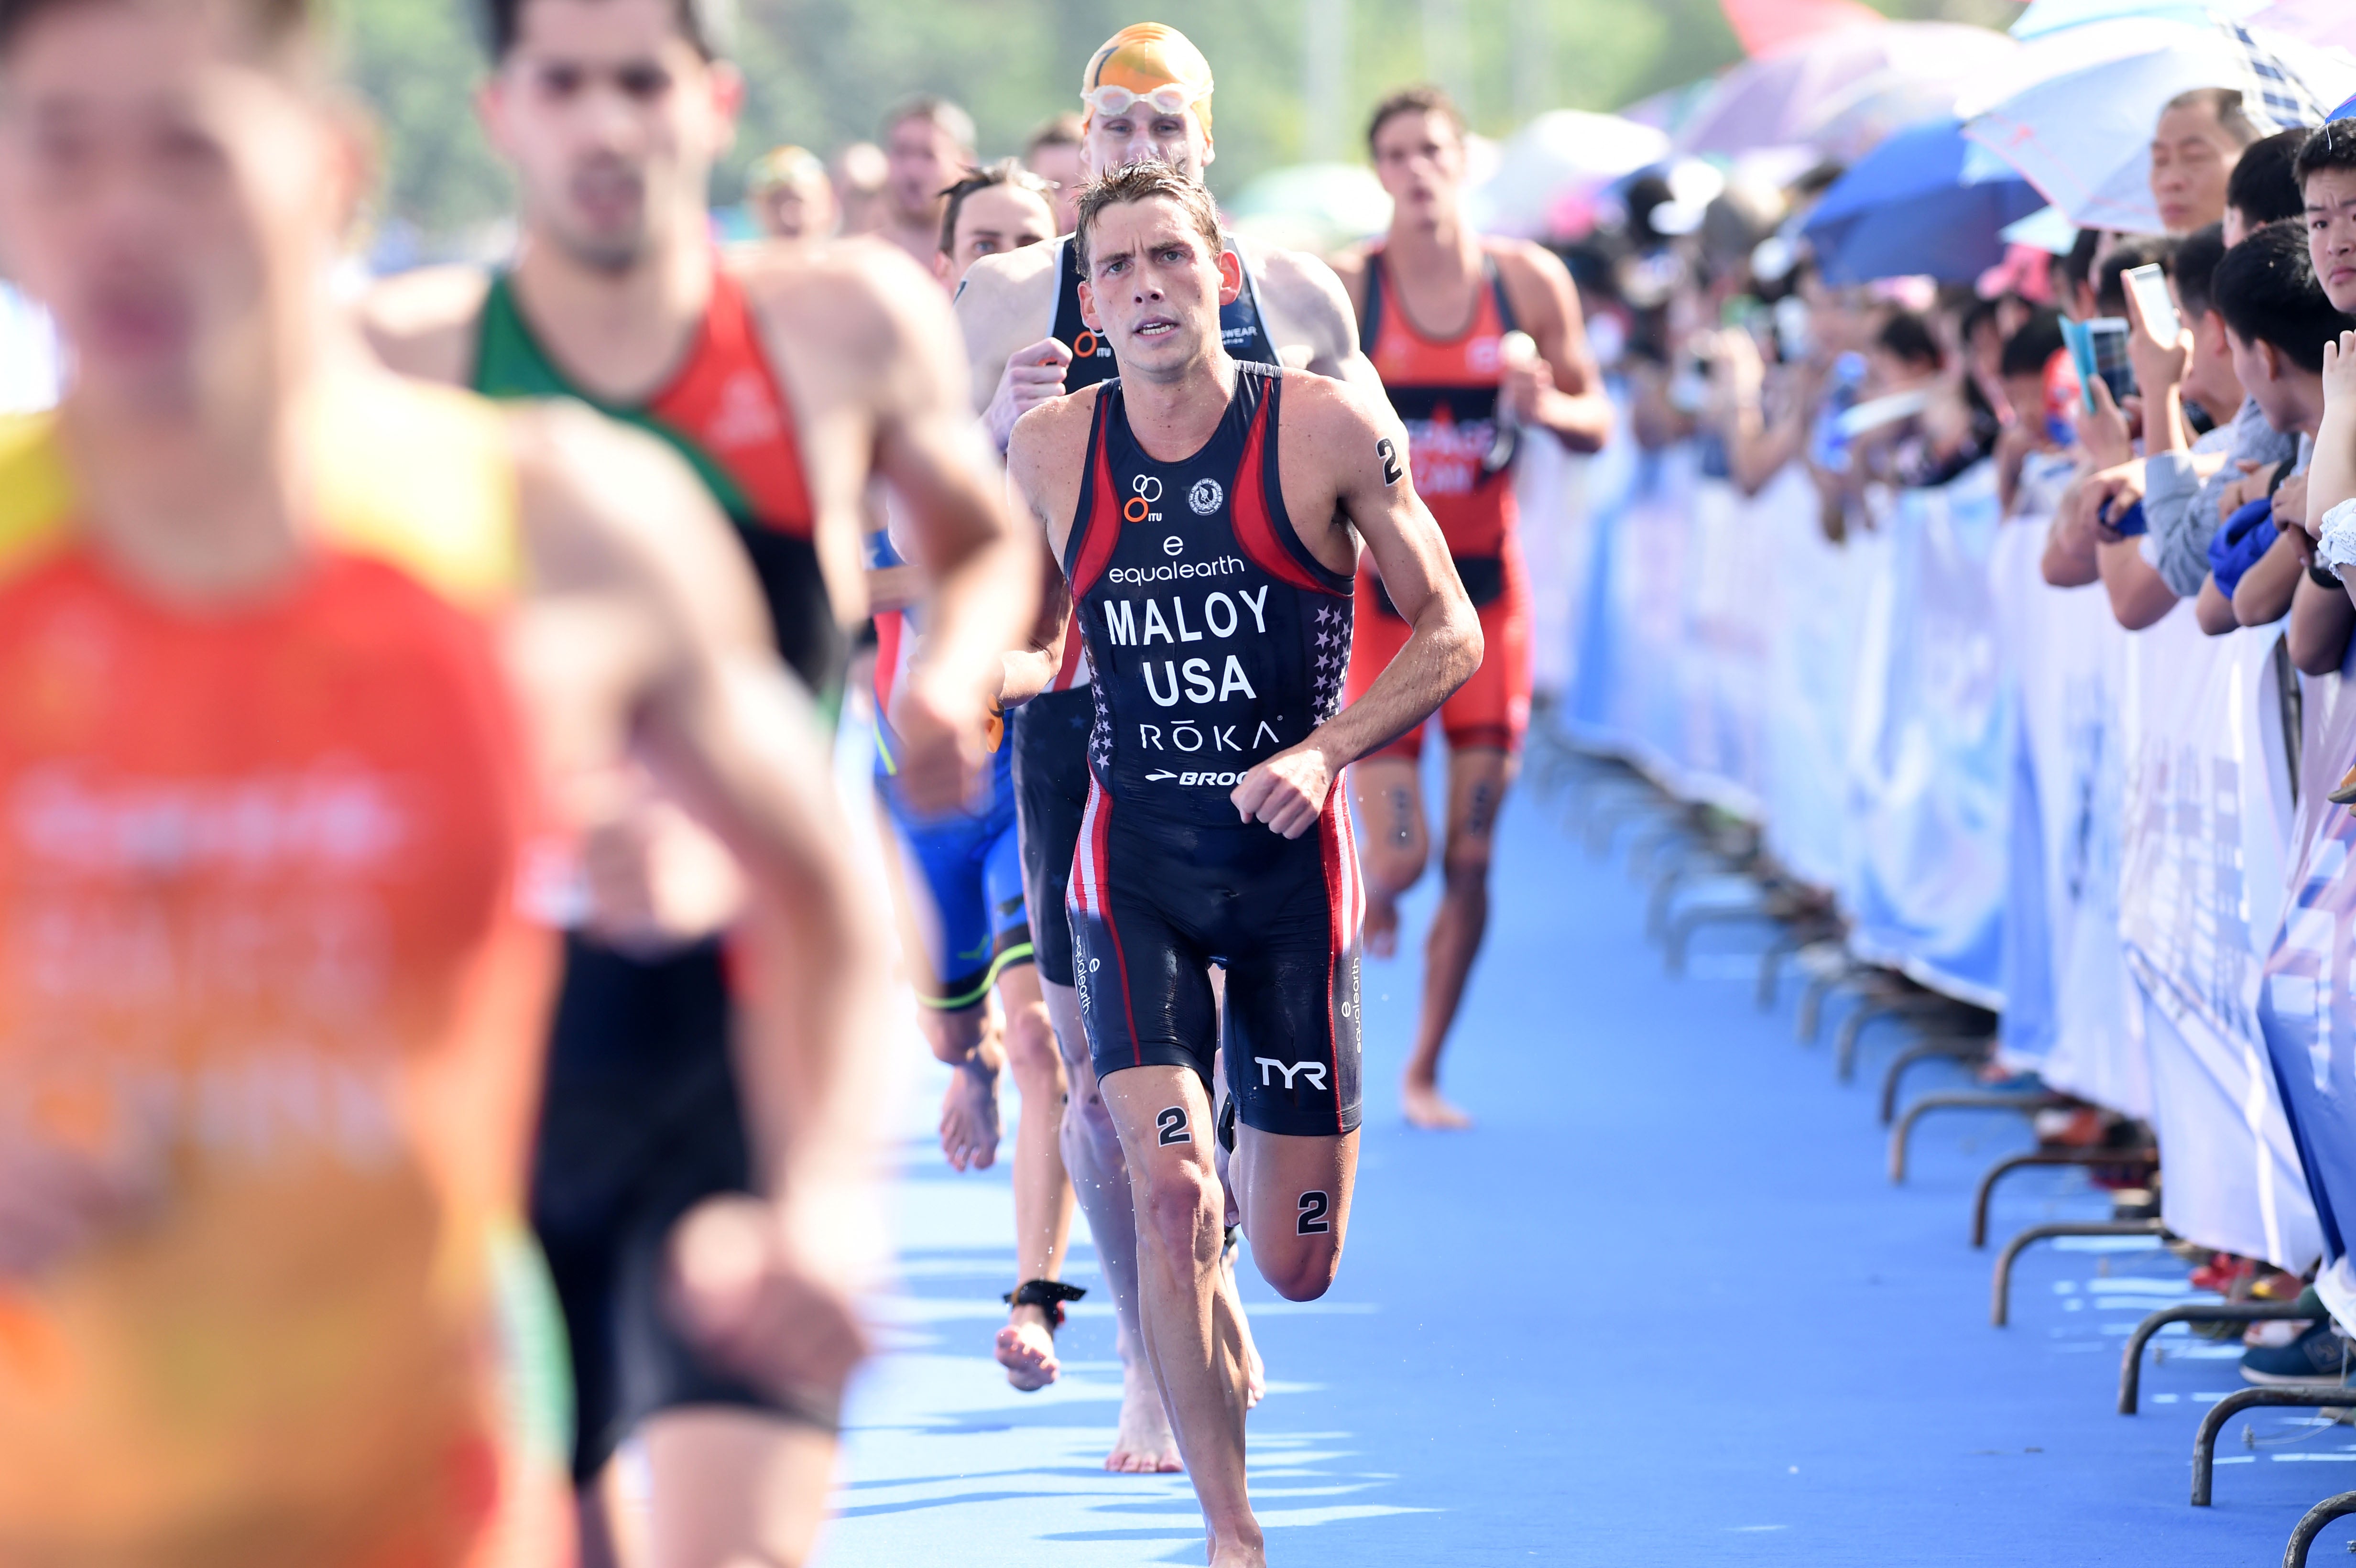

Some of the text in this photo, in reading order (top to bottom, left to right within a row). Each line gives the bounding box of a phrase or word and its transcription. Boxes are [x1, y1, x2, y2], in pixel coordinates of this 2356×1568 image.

[1096, 348, 1111, 358] ITU
[1375, 438, 1402, 487] 2
[1148, 513, 1162, 522] ITU
[1163, 536, 1183, 555] e
[1109, 555, 1244, 586] equalearth
[1104, 585, 1268, 645] MALOY
[1143, 655, 1257, 707] USA
[1075, 935, 1091, 1015] equalearth
[1352, 957, 1362, 1053] equalearth
[1254, 1057, 1327, 1090] TYR
[1155, 1106, 1192, 1147] 2
[1296, 1190, 1330, 1236] 2
